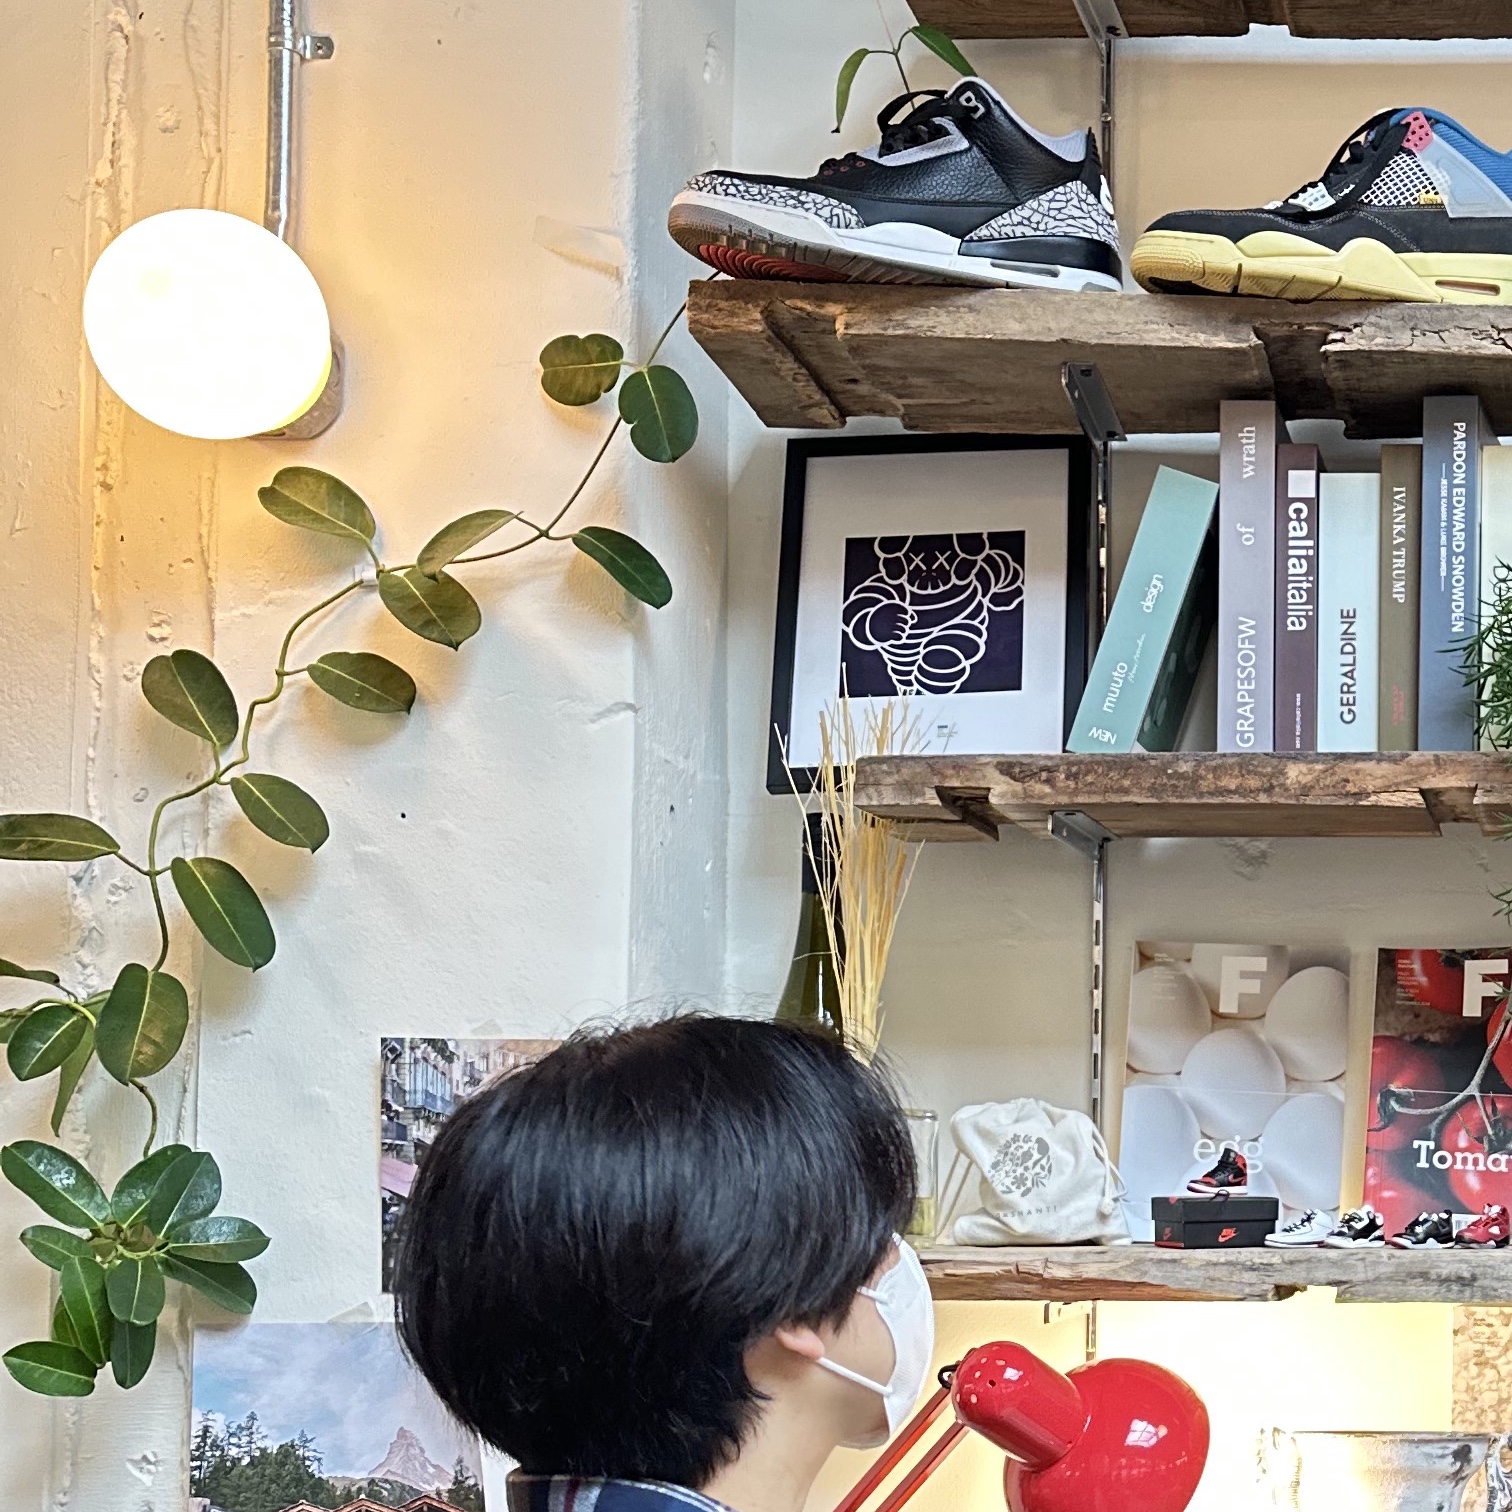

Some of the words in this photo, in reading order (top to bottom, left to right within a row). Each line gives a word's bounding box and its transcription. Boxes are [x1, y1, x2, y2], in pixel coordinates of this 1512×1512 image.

[1238, 426, 1256, 479] wrath
[1452, 422, 1466, 484] PARDON
[1236, 523, 1255, 546] of
[1392, 487, 1406, 544] IVANKA
[1452, 490, 1466, 554] EDWARD
[1143, 573, 1164, 613] design
[1287, 501, 1314, 631] caliaitalia
[1392, 549, 1406, 603] TRUMP
[1451, 555, 1466, 633] SNOWDEN
[1102, 662, 1129, 713] muuto
[1236, 616, 1257, 748] GRAPESOFW
[1340, 607, 1357, 725] GERALDINE
[1088, 726, 1118, 745] NEW
[1219, 955, 1268, 1013] F
[1462, 958, 1509, 1017] F
